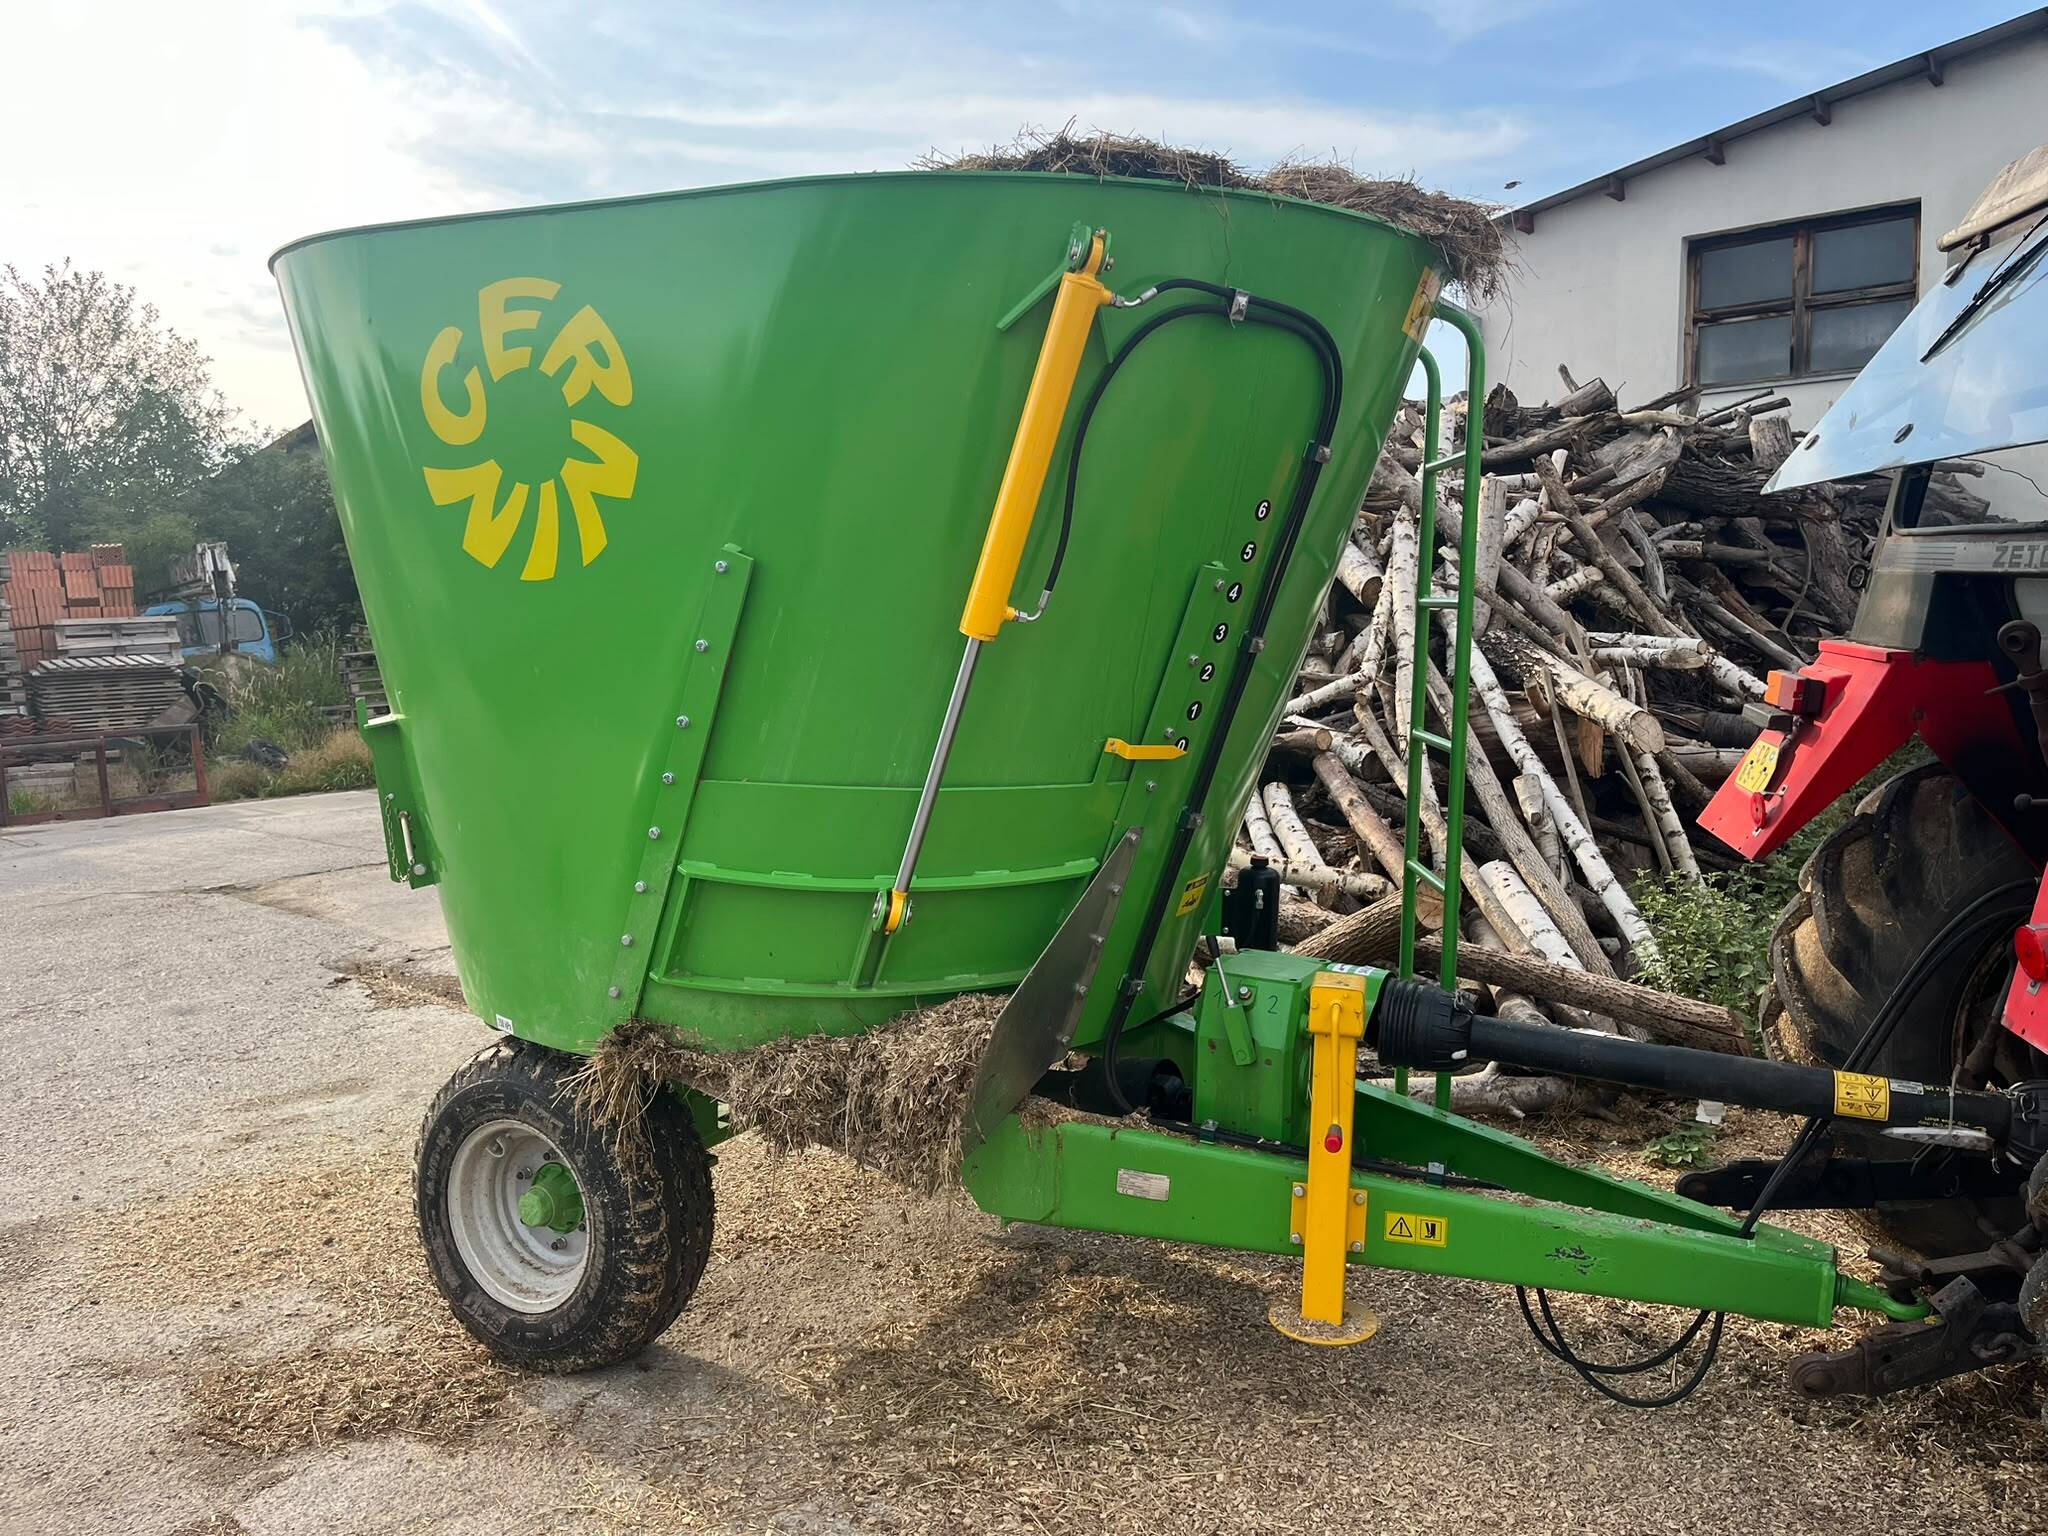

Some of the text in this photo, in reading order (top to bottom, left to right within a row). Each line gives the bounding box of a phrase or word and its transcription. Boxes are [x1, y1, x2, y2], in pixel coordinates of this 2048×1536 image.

[1258, 501, 1268, 518] 6
[1243, 543, 1254, 560] 5
[1229, 584, 1239, 600] 4
[1216, 625, 1226, 640] 3
[1201, 664, 1212, 680] 2
[1191, 703, 1199, 719] 1
[1267, 995, 1279, 1014] 2
